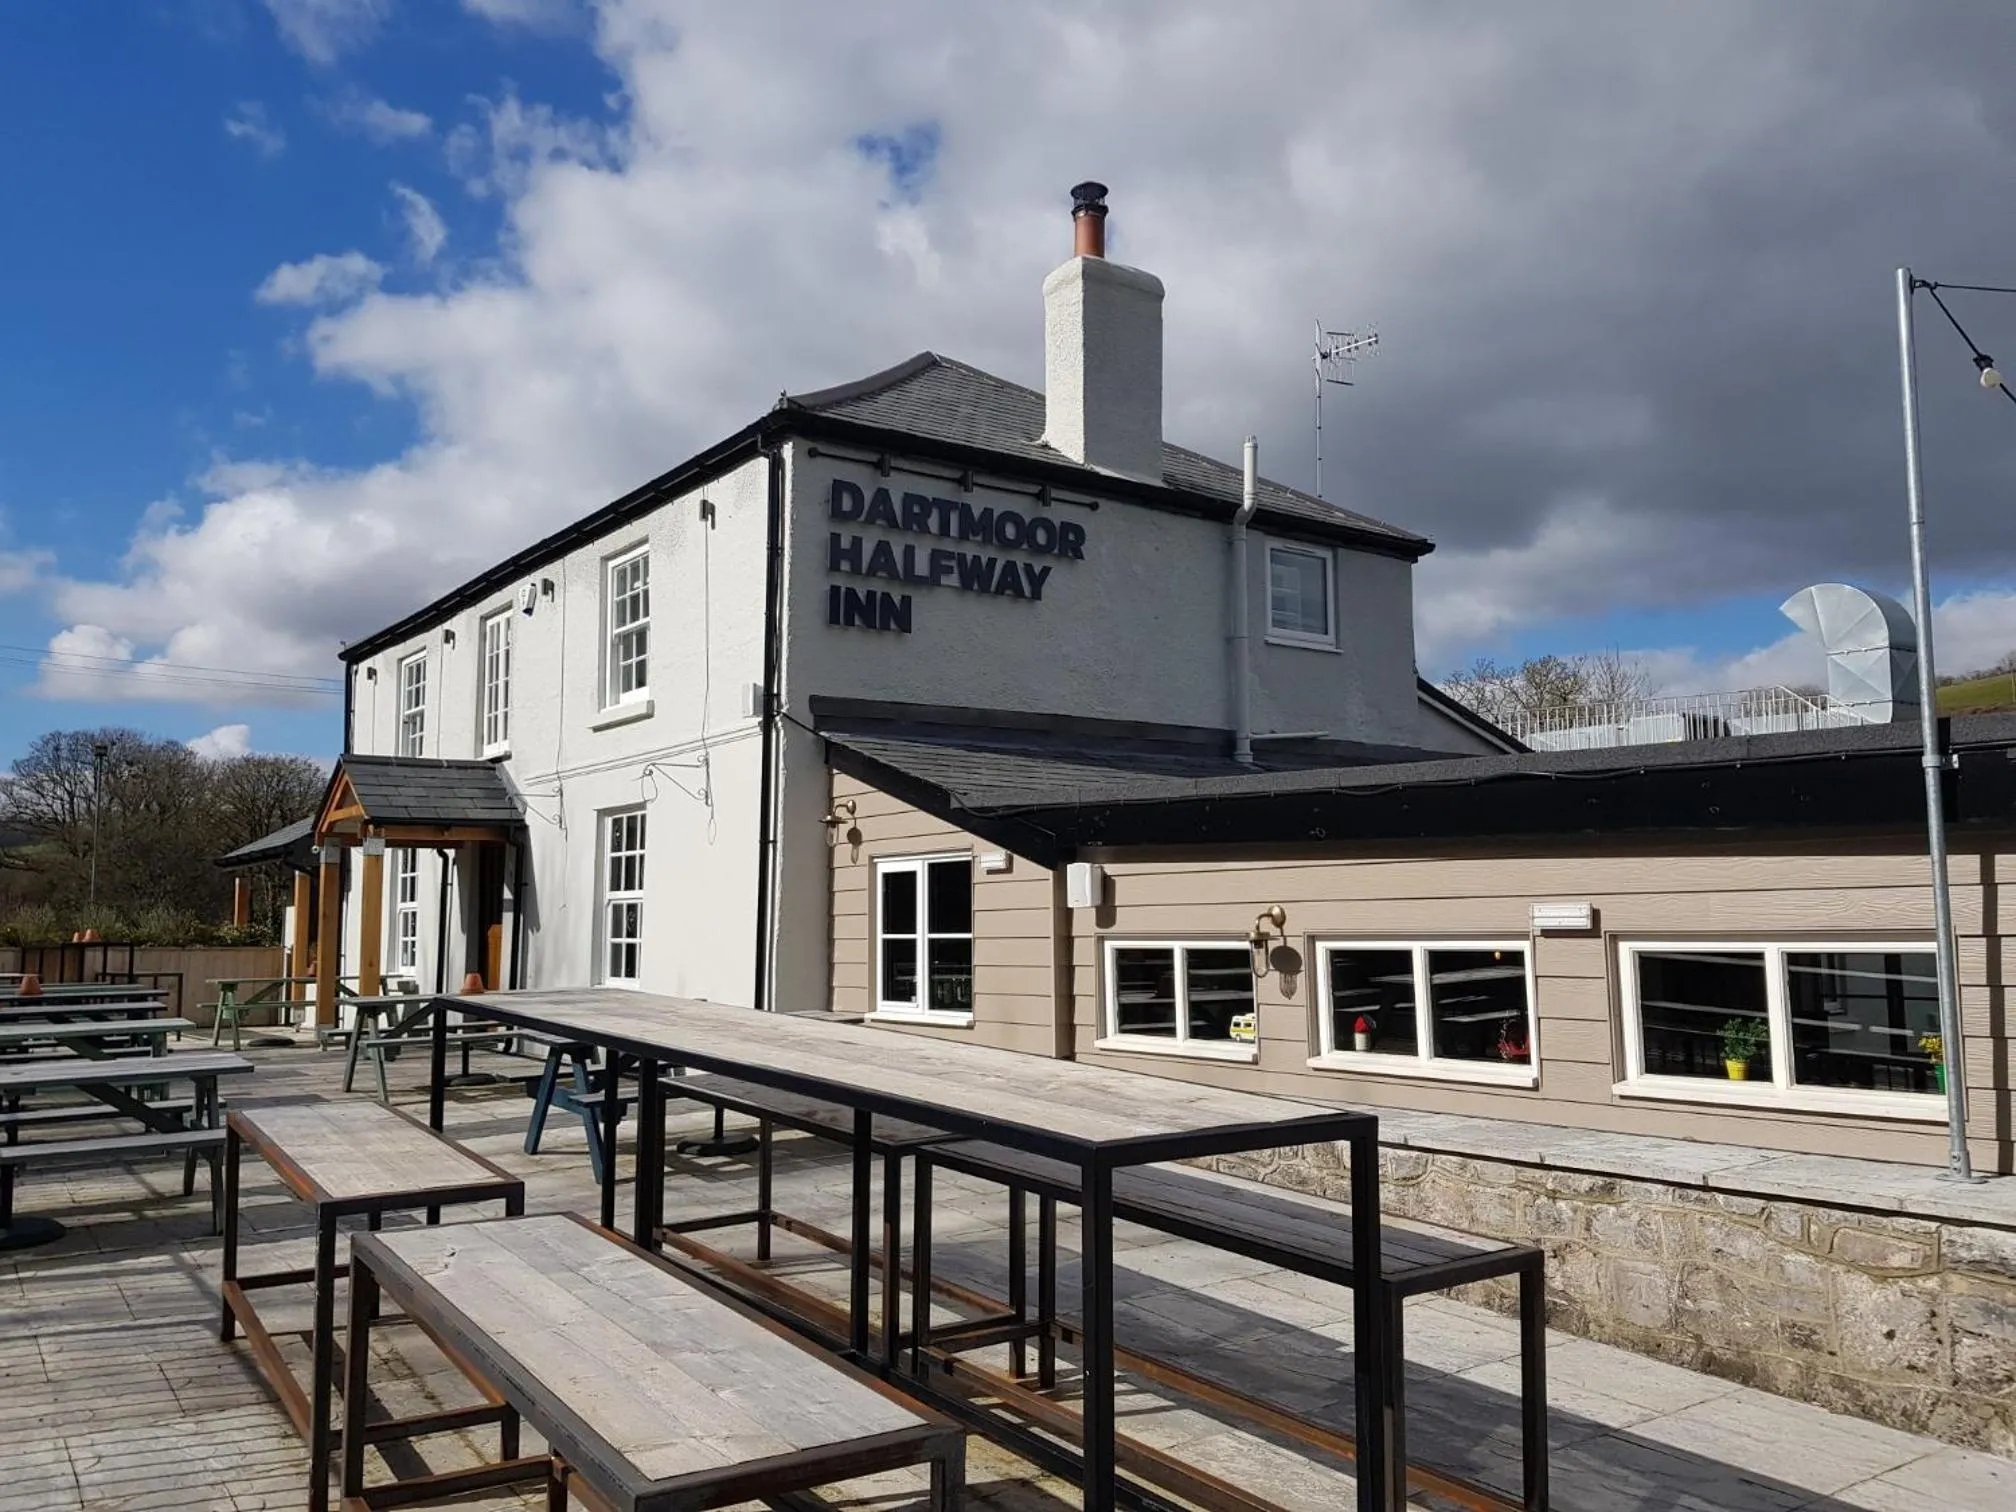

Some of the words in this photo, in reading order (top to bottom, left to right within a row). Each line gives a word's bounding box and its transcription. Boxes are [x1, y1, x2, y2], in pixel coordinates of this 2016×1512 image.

[830, 479, 1087, 560] DARTMOOR
[829, 532, 1052, 601] HALFWAY
[829, 585, 912, 633] INN
